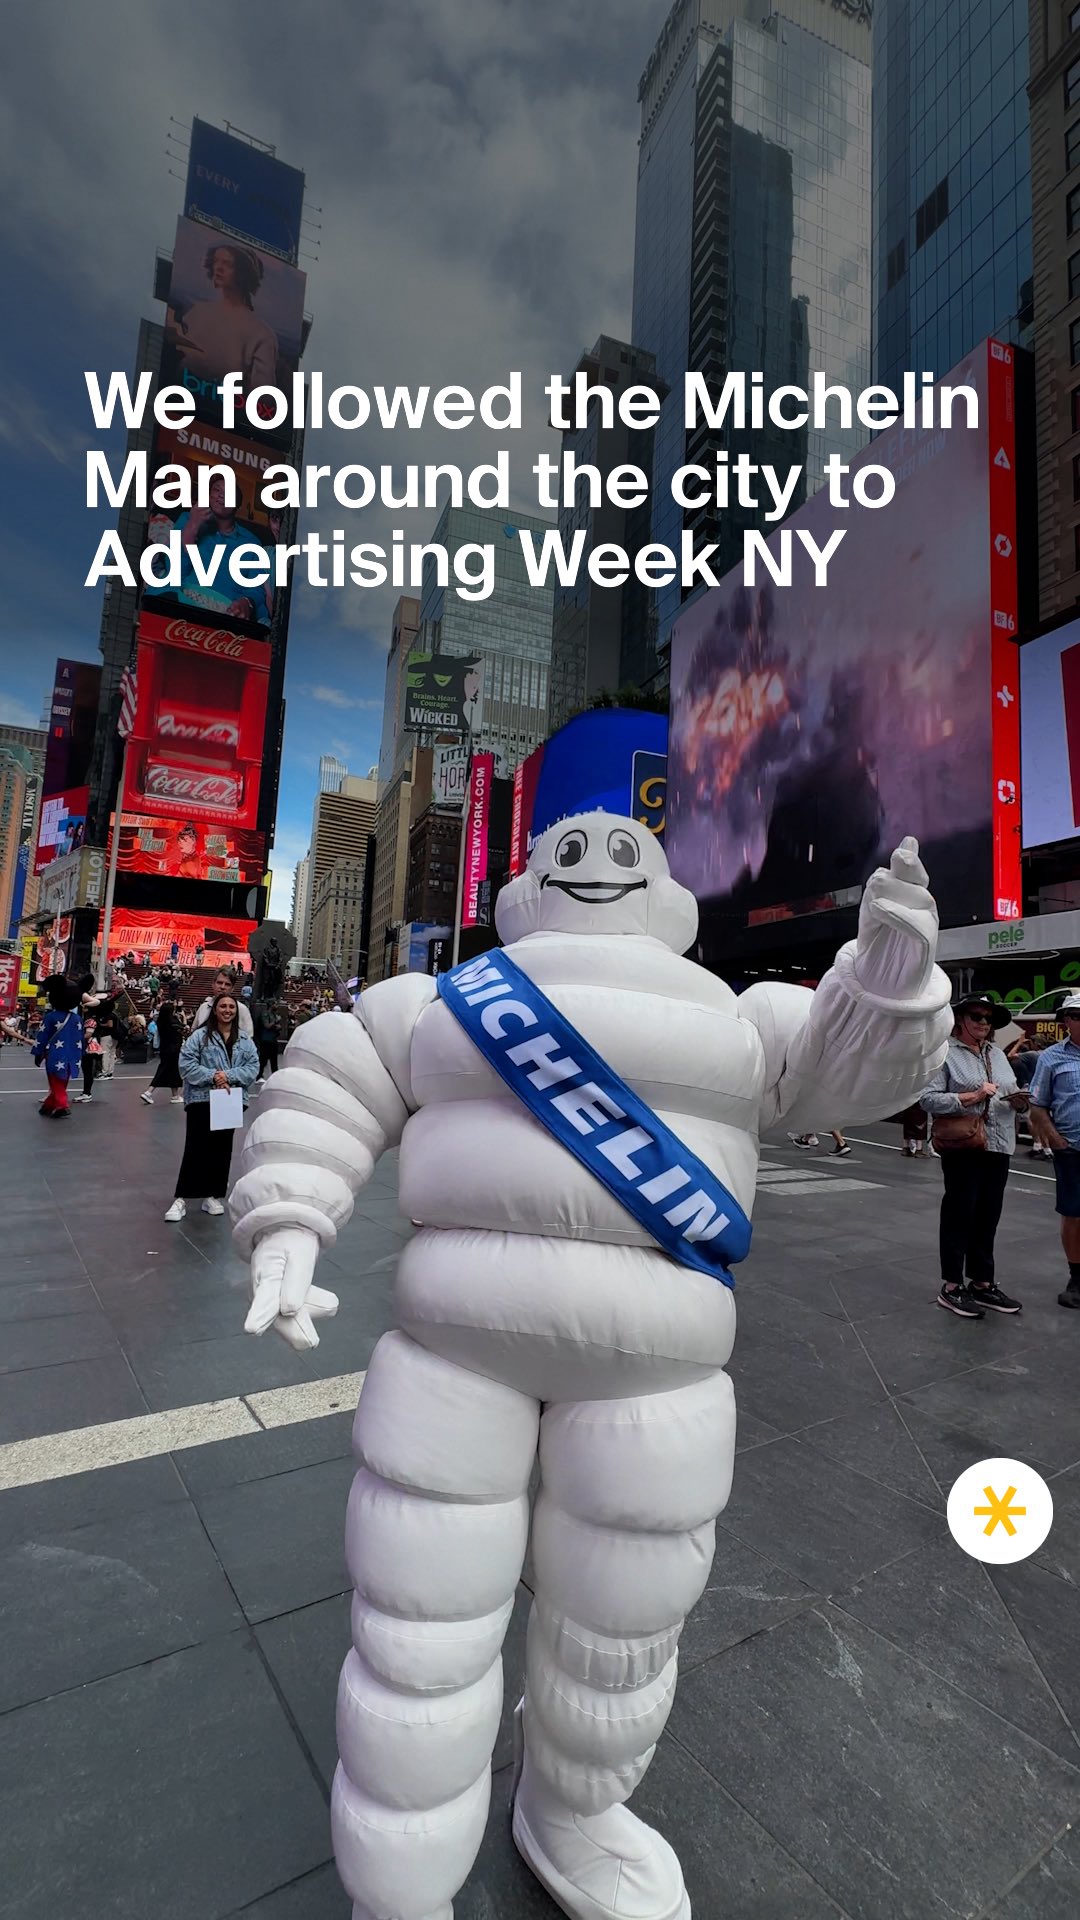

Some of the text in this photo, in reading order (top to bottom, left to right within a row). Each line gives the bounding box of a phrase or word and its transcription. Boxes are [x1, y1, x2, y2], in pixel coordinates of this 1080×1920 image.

[196, 164, 241, 193] EVERY
[176, 428, 271, 472] SAMSUNG
[164, 618, 249, 657] Coca-Cola
[468, 766, 486, 918] BEAUTYNEWYORK.COM
[86, 850, 105, 907] HELLO!
[119, 929, 197, 948] ONLY IN THEATERS
[0, 957, 15, 994] tkts
[1036, 1021, 1056, 1033] BIG
[450, 956, 730, 1245] MICHELIN
